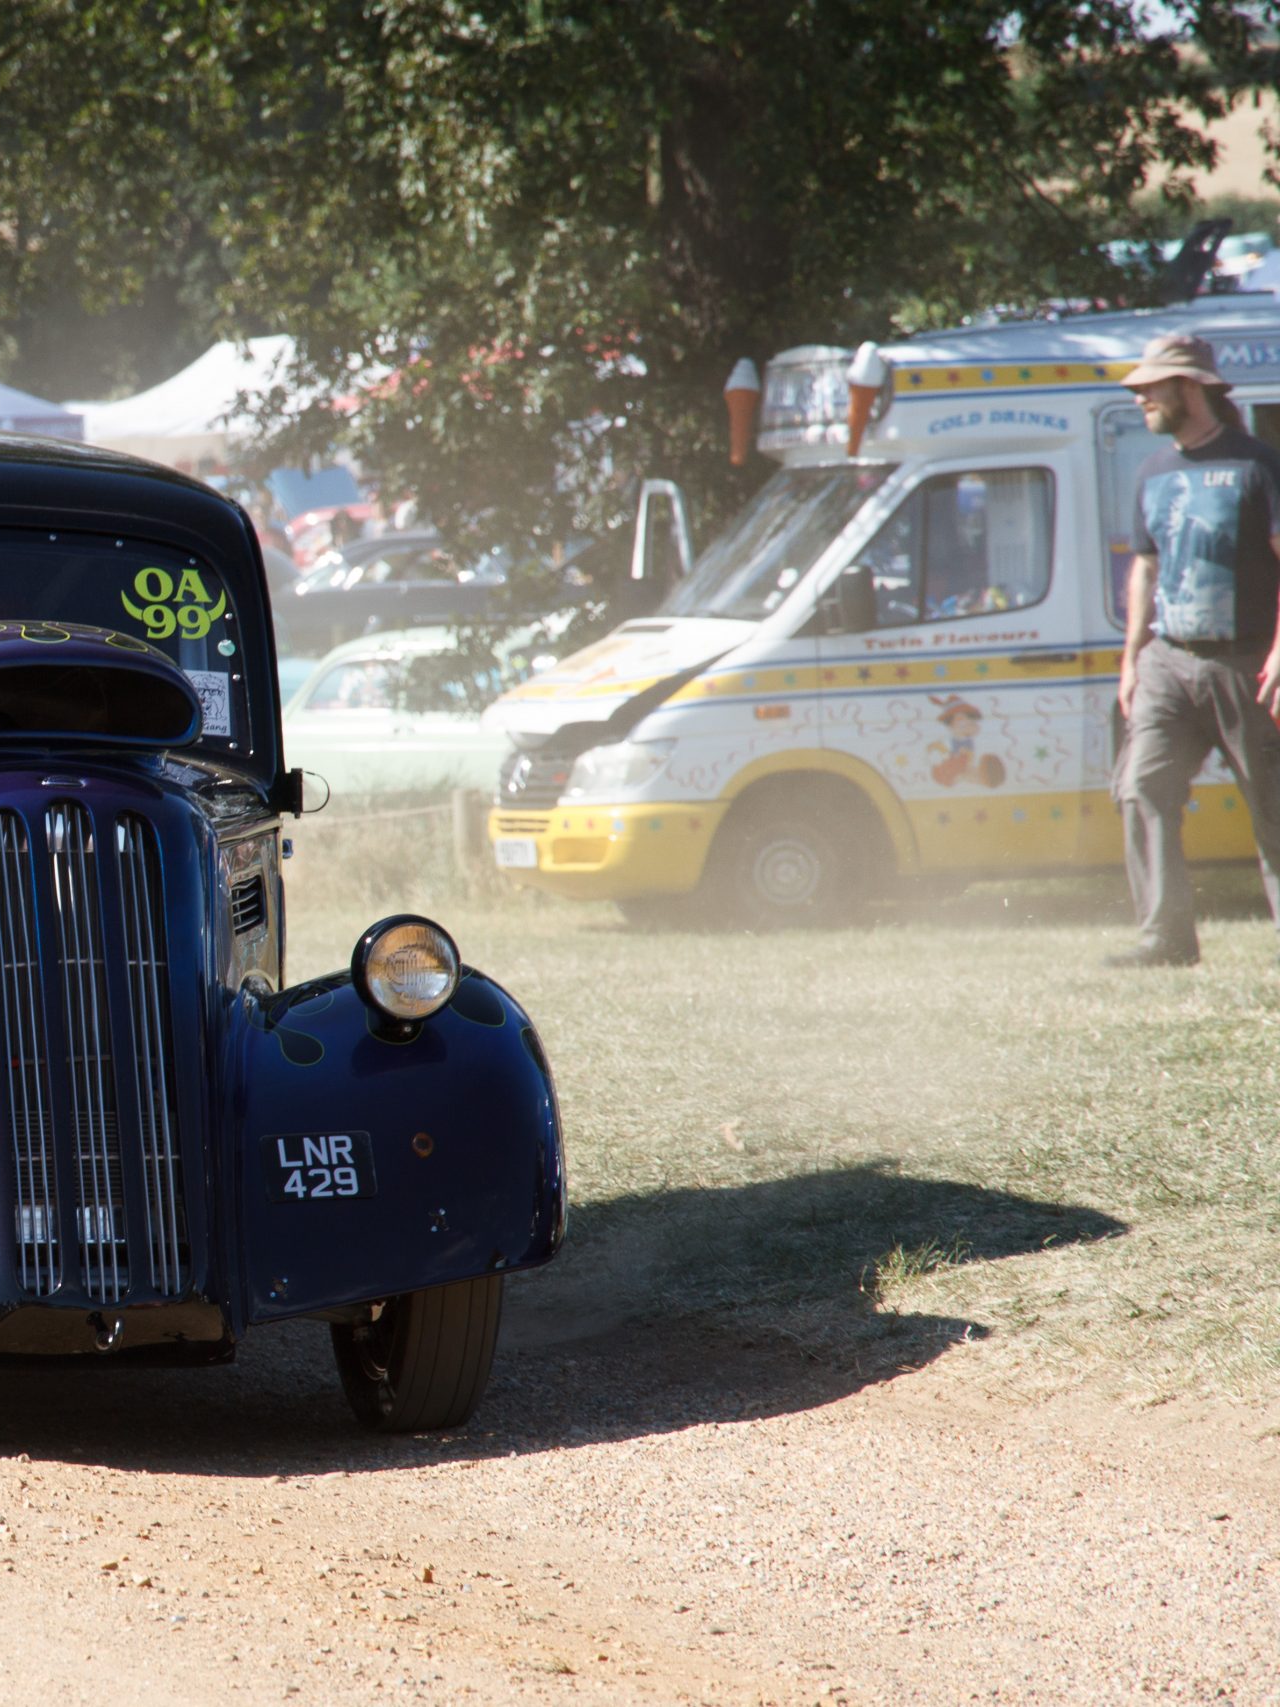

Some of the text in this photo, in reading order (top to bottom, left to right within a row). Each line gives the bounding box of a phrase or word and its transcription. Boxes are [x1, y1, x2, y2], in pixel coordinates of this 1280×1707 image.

[928, 409, 1068, 436] COLD DRINKS
[1203, 470, 1235, 488] LIFE
[134, 567, 213, 603] OA
[142, 604, 211, 640] 99
[863, 629, 1041, 651] Twin Flavours
[277, 1135, 355, 1168] LNR
[283, 1167, 359, 1199] 429
